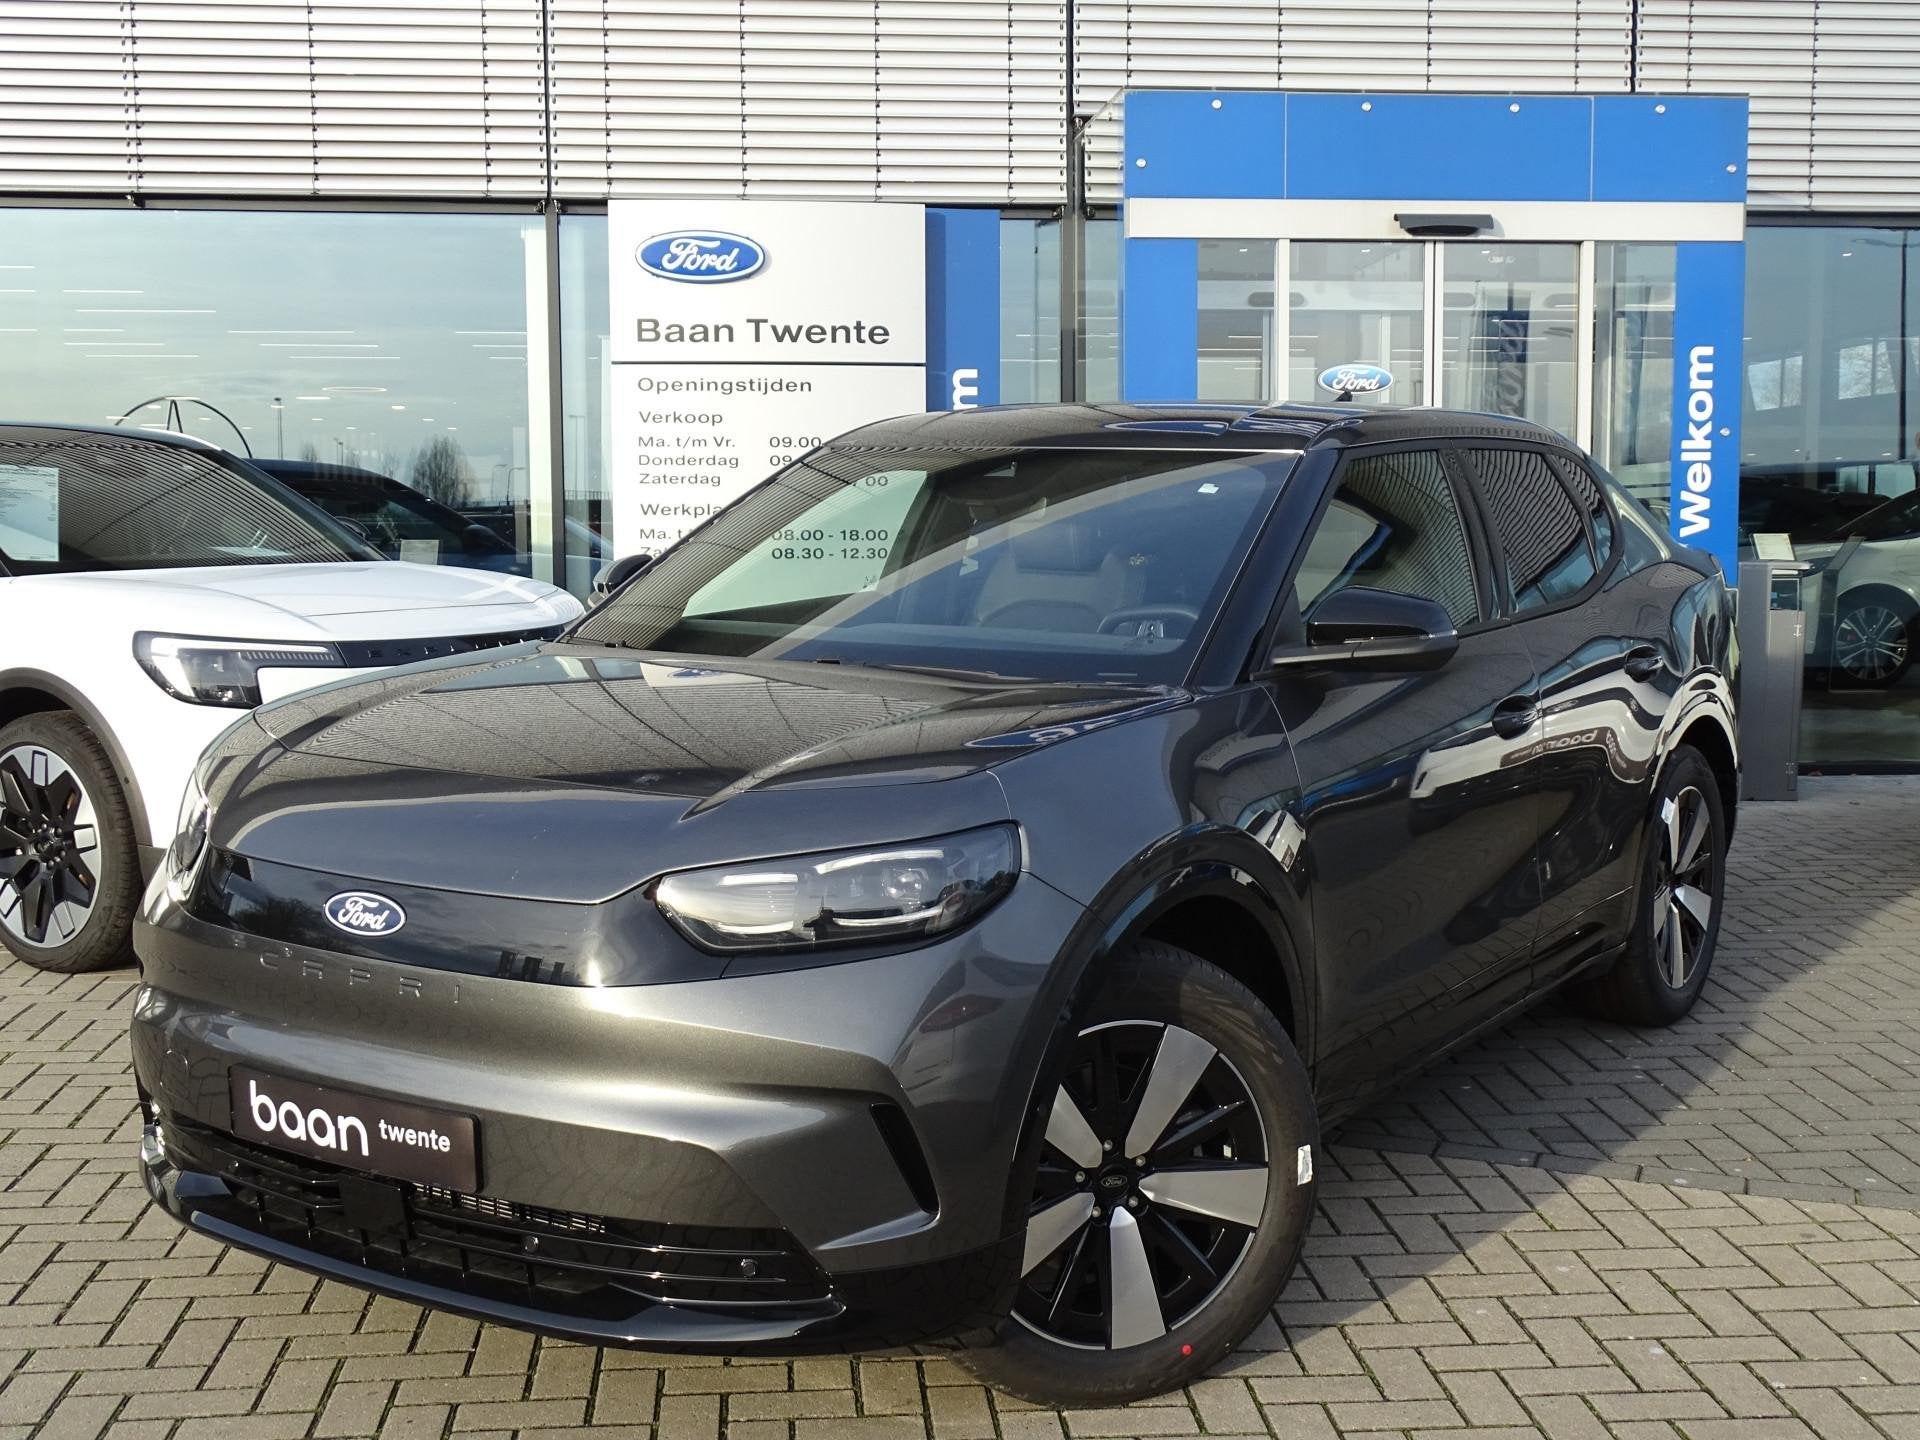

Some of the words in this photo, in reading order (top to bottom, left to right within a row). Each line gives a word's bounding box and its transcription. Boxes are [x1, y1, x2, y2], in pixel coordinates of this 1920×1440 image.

[637, 318, 735, 343] Baan
[746, 318, 891, 345] Twente
[637, 377, 813, 396] Openingstijden
[638, 411, 724, 427] Verkoop
[638, 436, 671, 448] Ma.
[676, 435, 708, 449] t/m
[713, 436, 736, 448] Vr.
[769, 436, 822, 448] 09.00
[1679, 345, 1715, 538] Welkom
[638, 454, 740, 469] Donderdag
[639, 473, 722, 487] Zaterdag
[640, 503, 723, 519] Werkpla
[640, 528, 672, 540] Ma.
[771, 529, 824, 541] 08.00
[839, 529, 889, 541] 18.00
[771, 547, 824, 560] 08.30
[840, 547, 888, 560] 12.30
[259, 951, 462, 1004] CAPRI
[249, 1079, 370, 1157] baan
[378, 1118, 451, 1153] twente
